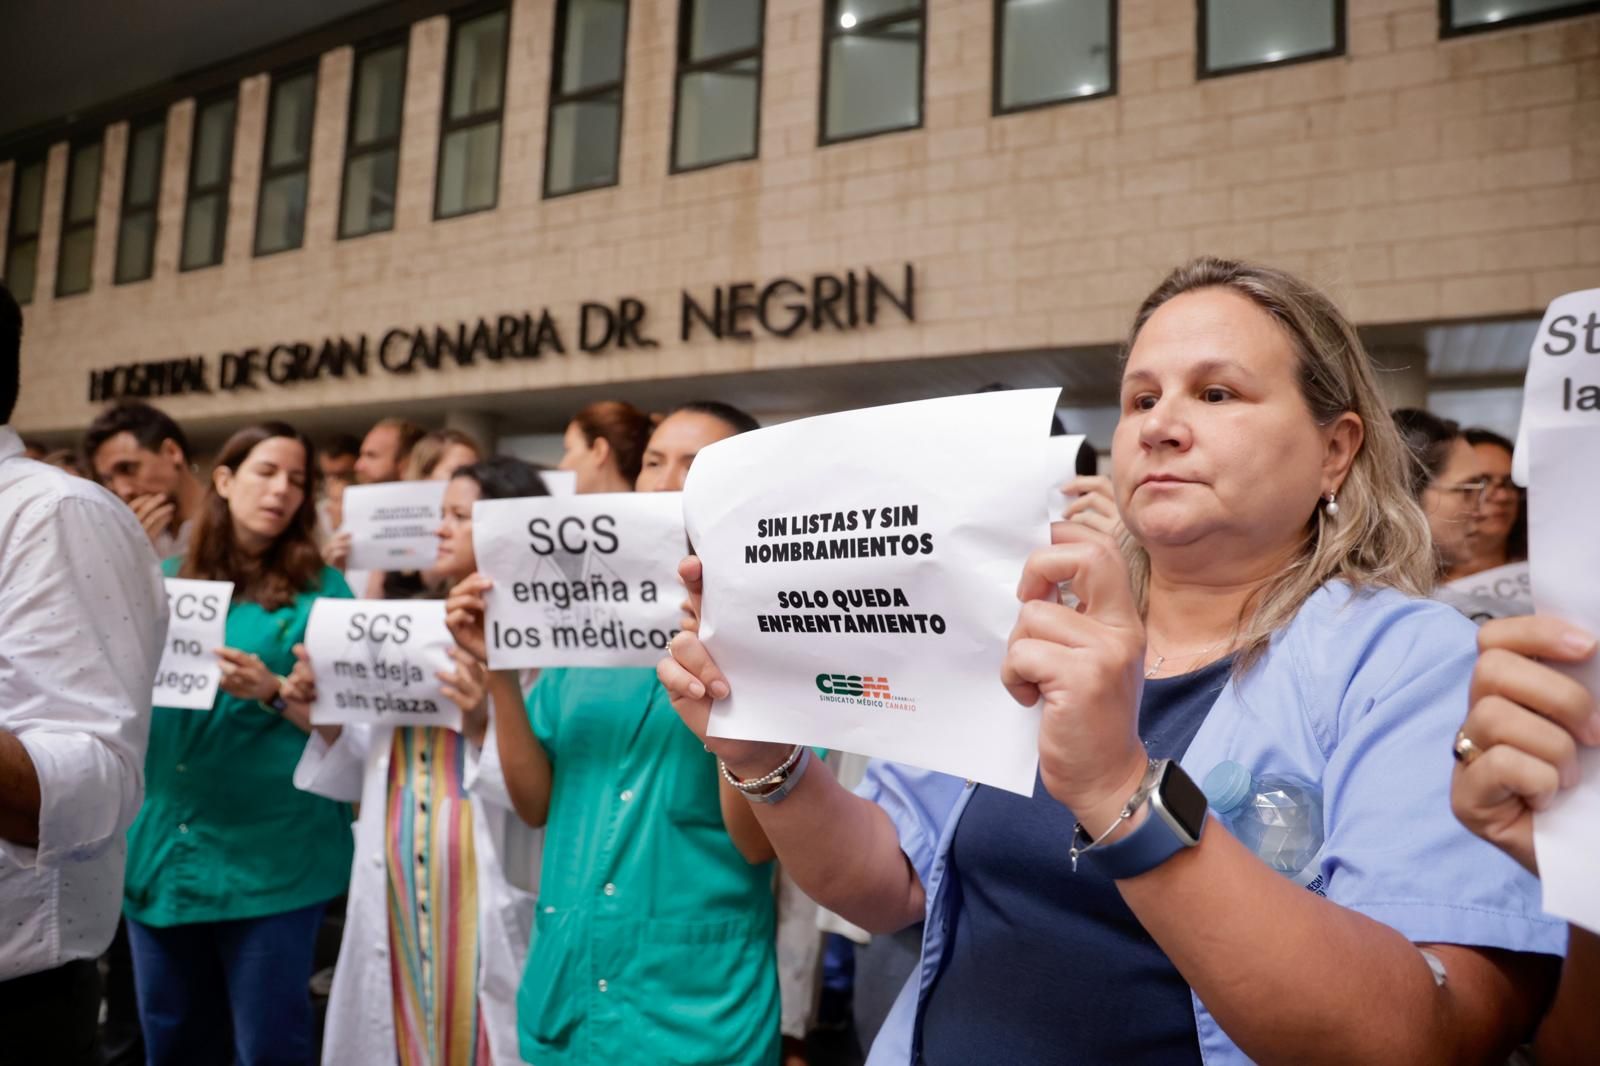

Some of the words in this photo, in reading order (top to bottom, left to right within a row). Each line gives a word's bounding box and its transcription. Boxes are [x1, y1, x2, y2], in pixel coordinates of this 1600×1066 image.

[89, 355, 211, 403] HOSPITAL
[220, 348, 261, 390] DE
[266, 334, 368, 385] GRAN
[379, 308, 565, 375] CANARIA
[578, 297, 658, 353] DR.
[681, 262, 916, 343] NEGRIN
[528, 515, 619, 556] SCS
[757, 517, 787, 538] SIN
[791, 510, 858, 535] LISTAS
[862, 508, 876, 529] Y
[880, 504, 918, 528] SIN
[745, 533, 934, 564] NOMBRAMIENTOS
[513, 574, 629, 609] engaña
[640, 580, 658, 602] a
[777, 590, 829, 609] SOLO
[832, 588, 910, 612] QUEDA
[346, 613, 412, 644] SCS
[493, 621, 541, 649] los
[757, 614, 946, 635] ENFRENTAMIENTO
[172, 636, 202, 657] no
[334, 660, 368, 678] me
[373, 656, 424, 687] deja
[816, 673, 891, 699] CESM
[335, 688, 369, 710] sin
[373, 692, 439, 716] plaza
[819, 695, 855, 705] SINDICATO
[856, 697, 883, 708] MÉDICO
[885, 702, 916, 712] CANARIO
